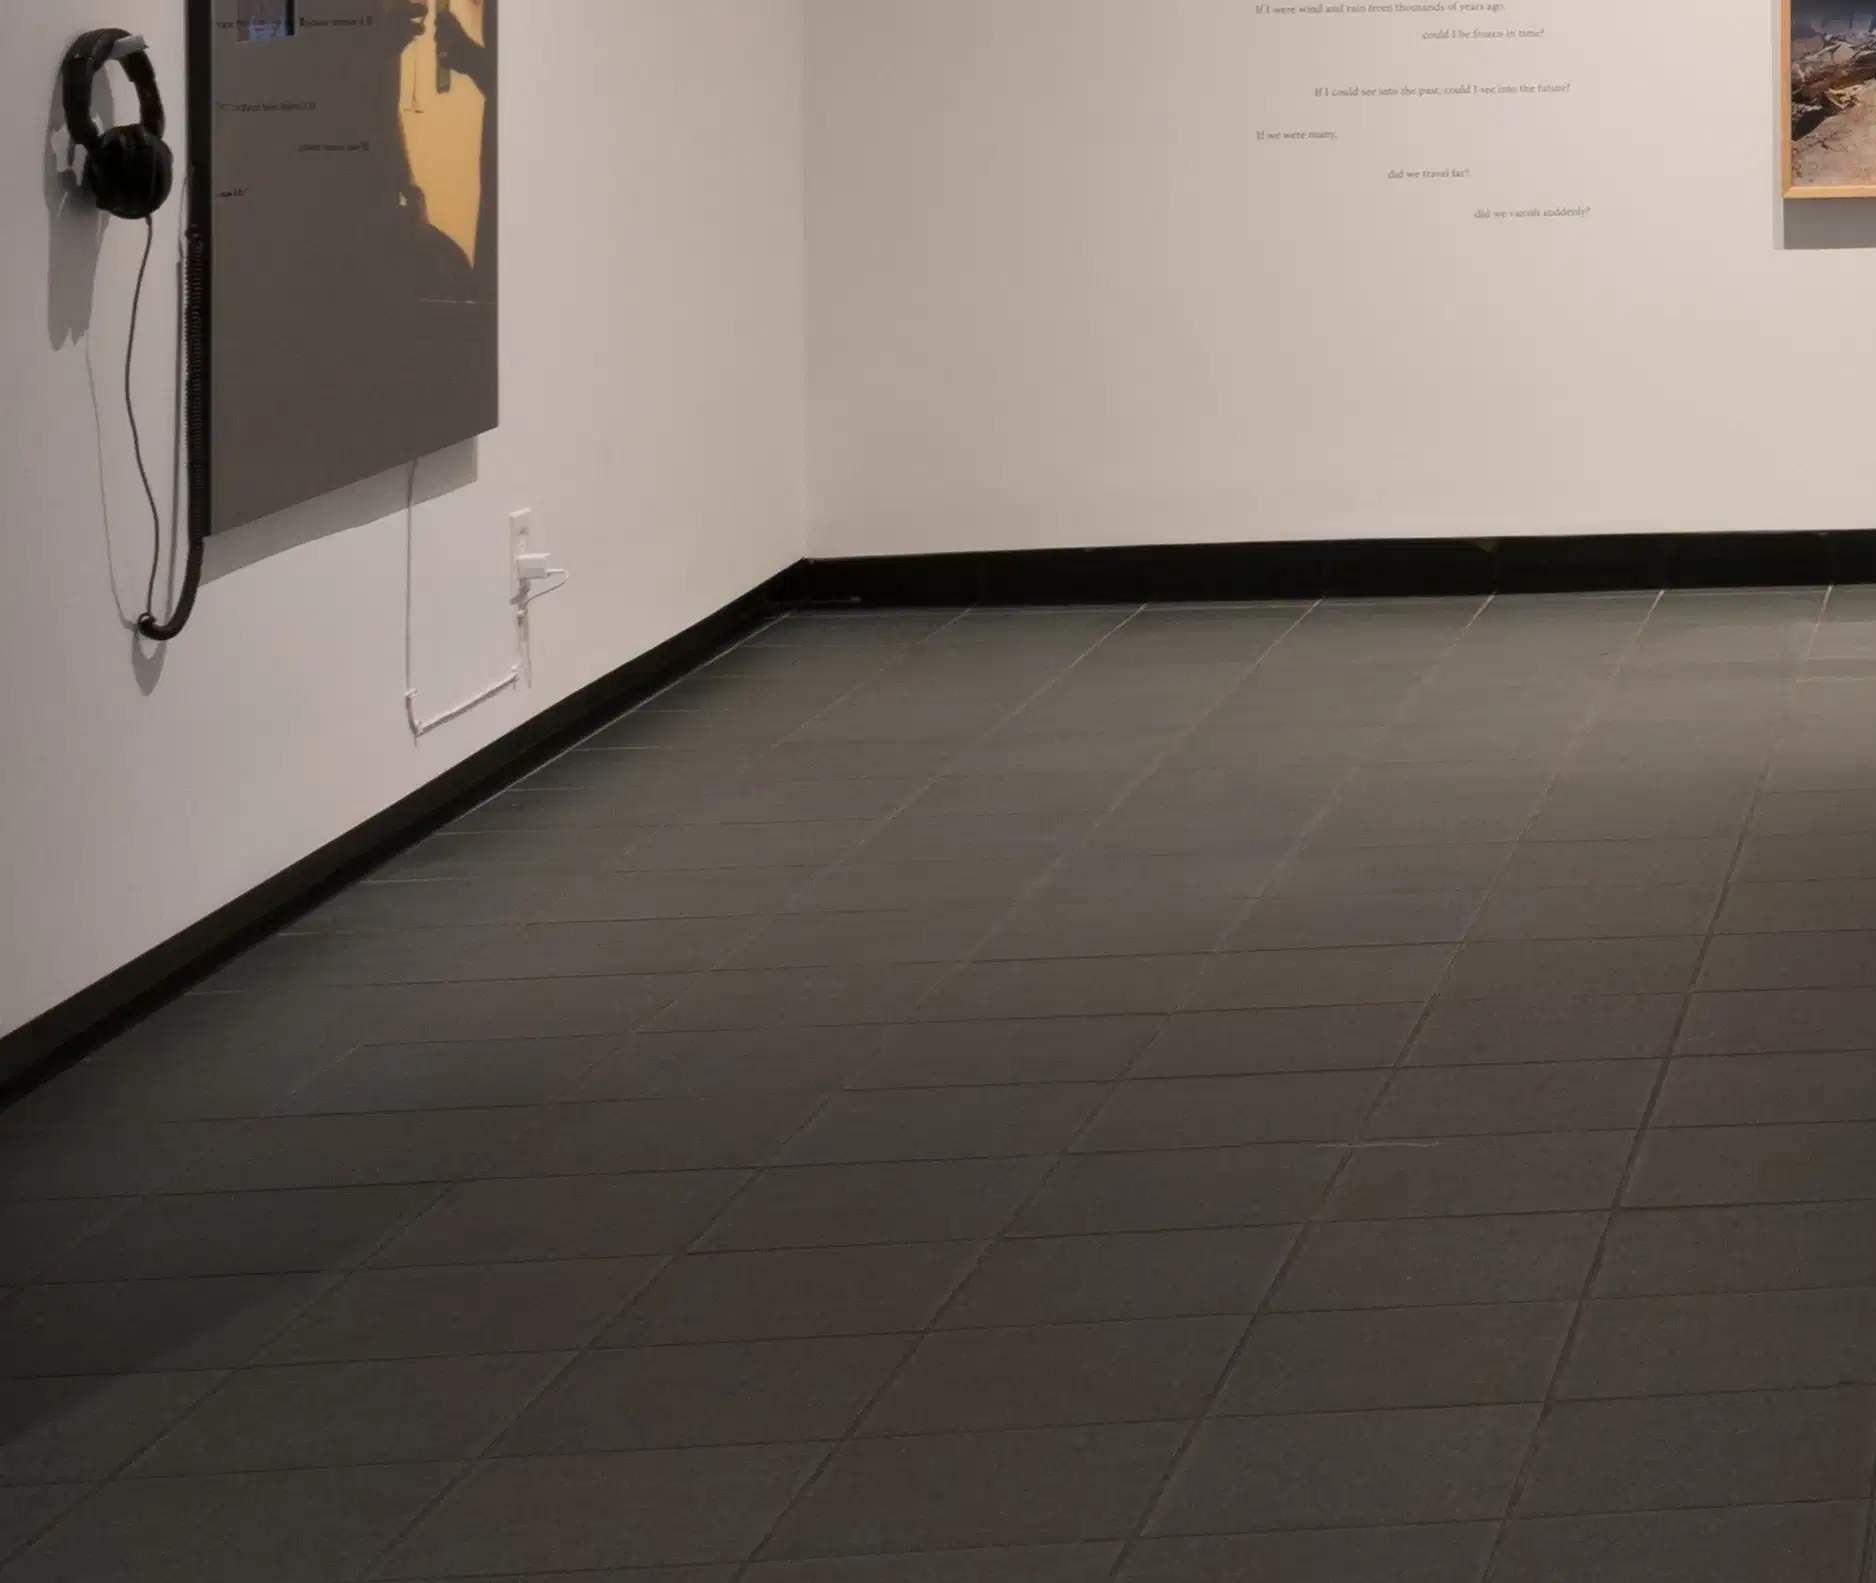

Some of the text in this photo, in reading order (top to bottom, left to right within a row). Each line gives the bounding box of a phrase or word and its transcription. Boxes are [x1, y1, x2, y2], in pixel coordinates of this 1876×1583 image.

[1256, 3, 1265, 16] If
[1273, 7, 1296, 15] were
[1326, 3, 1344, 14] and
[1346, 3, 1366, 13] rain
[1368, 3, 1393, 13] from
[1395, 1, 1444, 13] thousands
[1447, 0, 1459, 12] of
[1459, 3, 1485, 13] years
[1421, 27, 1450, 40] could
[1458, 29, 1471, 40] be
[1506, 29, 1517, 39] in
[1518, 27, 1544, 38] time?
[1315, 87, 1323, 98] If
[1331, 85, 1359, 97] could
[1361, 88, 1377, 97] see
[1379, 87, 1398, 97] into
[1400, 85, 1416, 96] the
[1443, 83, 1470, 95] could
[1480, 86, 1496, 95] see
[1497, 84, 1517, 94] into
[1519, 83, 1535, 93] the
[1537, 82, 1572, 93] future?
[1256, 129, 1265, 141] If
[1267, 132, 1281, 141] we
[1283, 131, 1304, 140] were
[1387, 167, 1470, 180] did we travel far?
[1474, 207, 1491, 220] did
[1492, 211, 1506, 219] we
